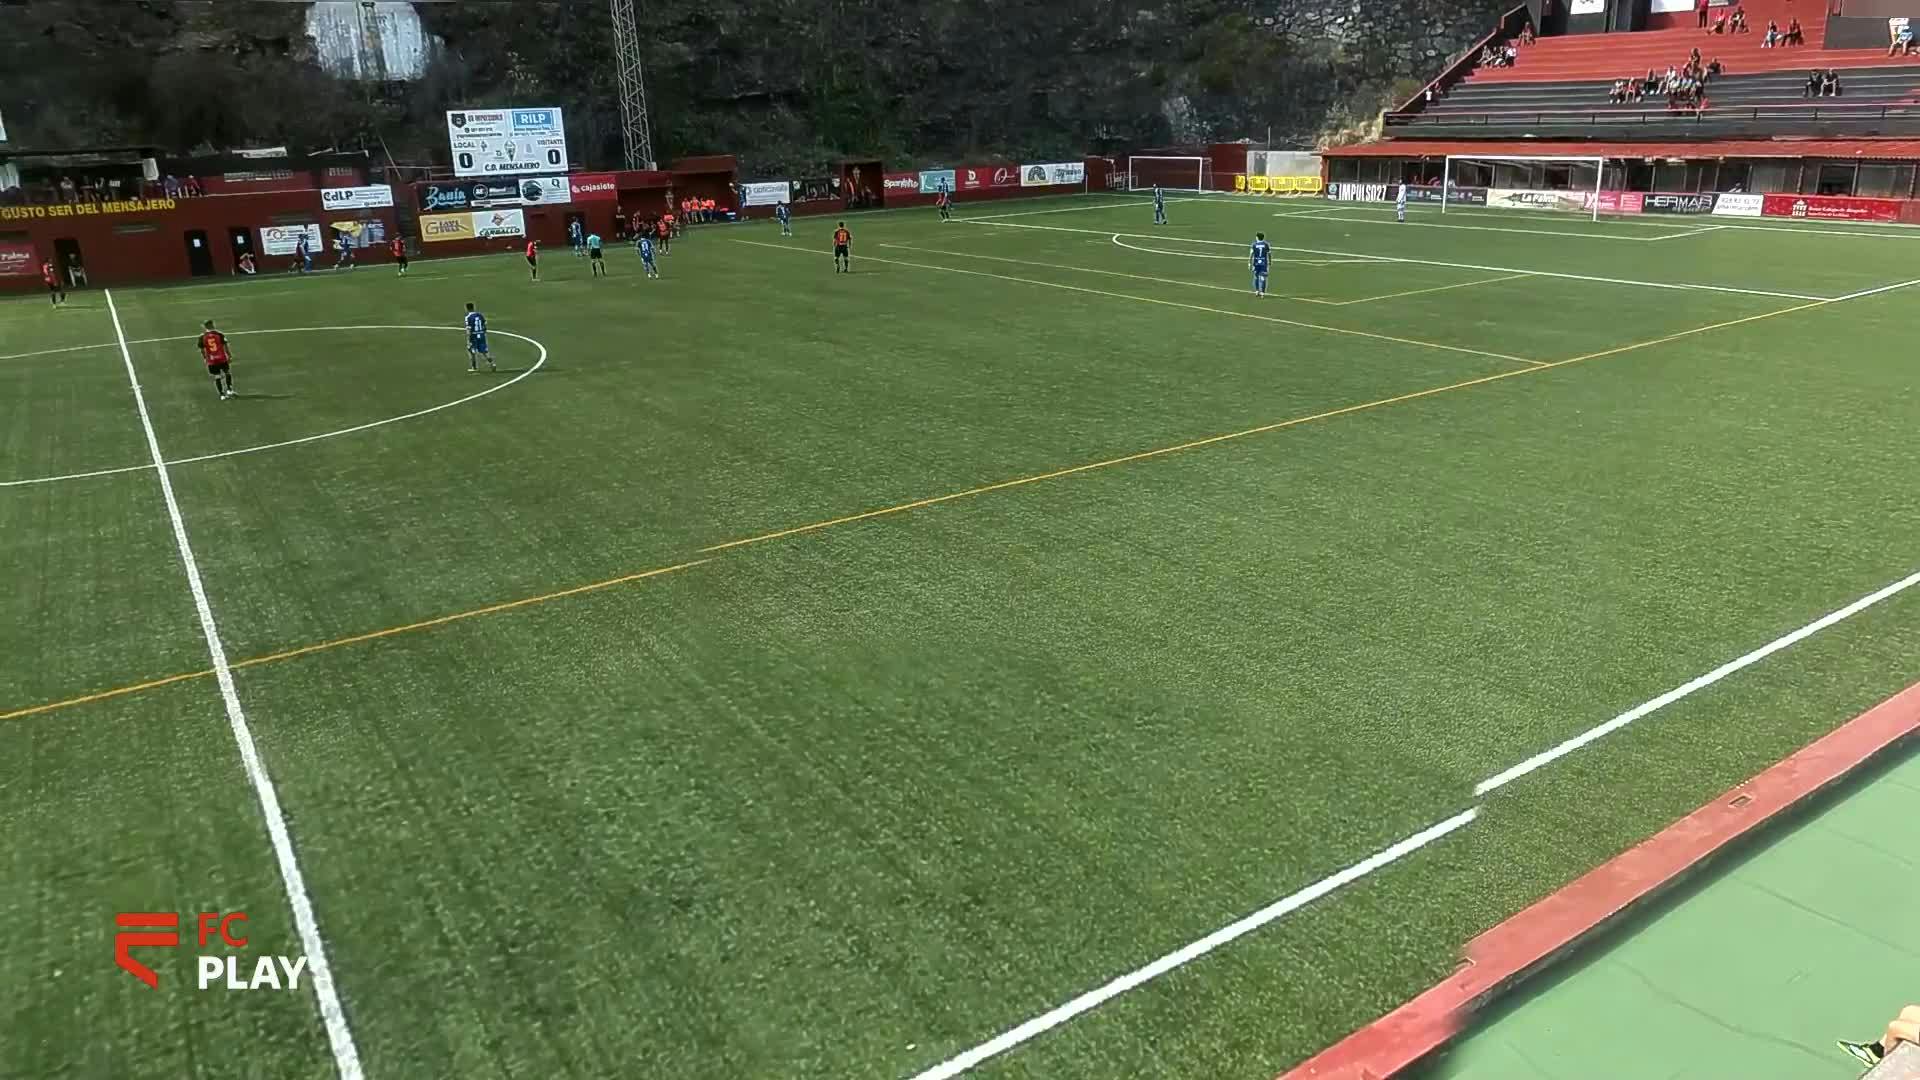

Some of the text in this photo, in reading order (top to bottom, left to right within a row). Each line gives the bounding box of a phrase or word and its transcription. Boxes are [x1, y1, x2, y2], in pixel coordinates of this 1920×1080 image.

[521, 114, 546, 124] RILP
[499, 162, 540, 171] MENSAJERO
[323, 190, 354, 201] CdLP
[1338, 184, 1387, 201] IMPULSO27
[1, 199, 176, 219] GUSTO SER DEL MENSAJERO
[207, 338, 218, 352] 5
